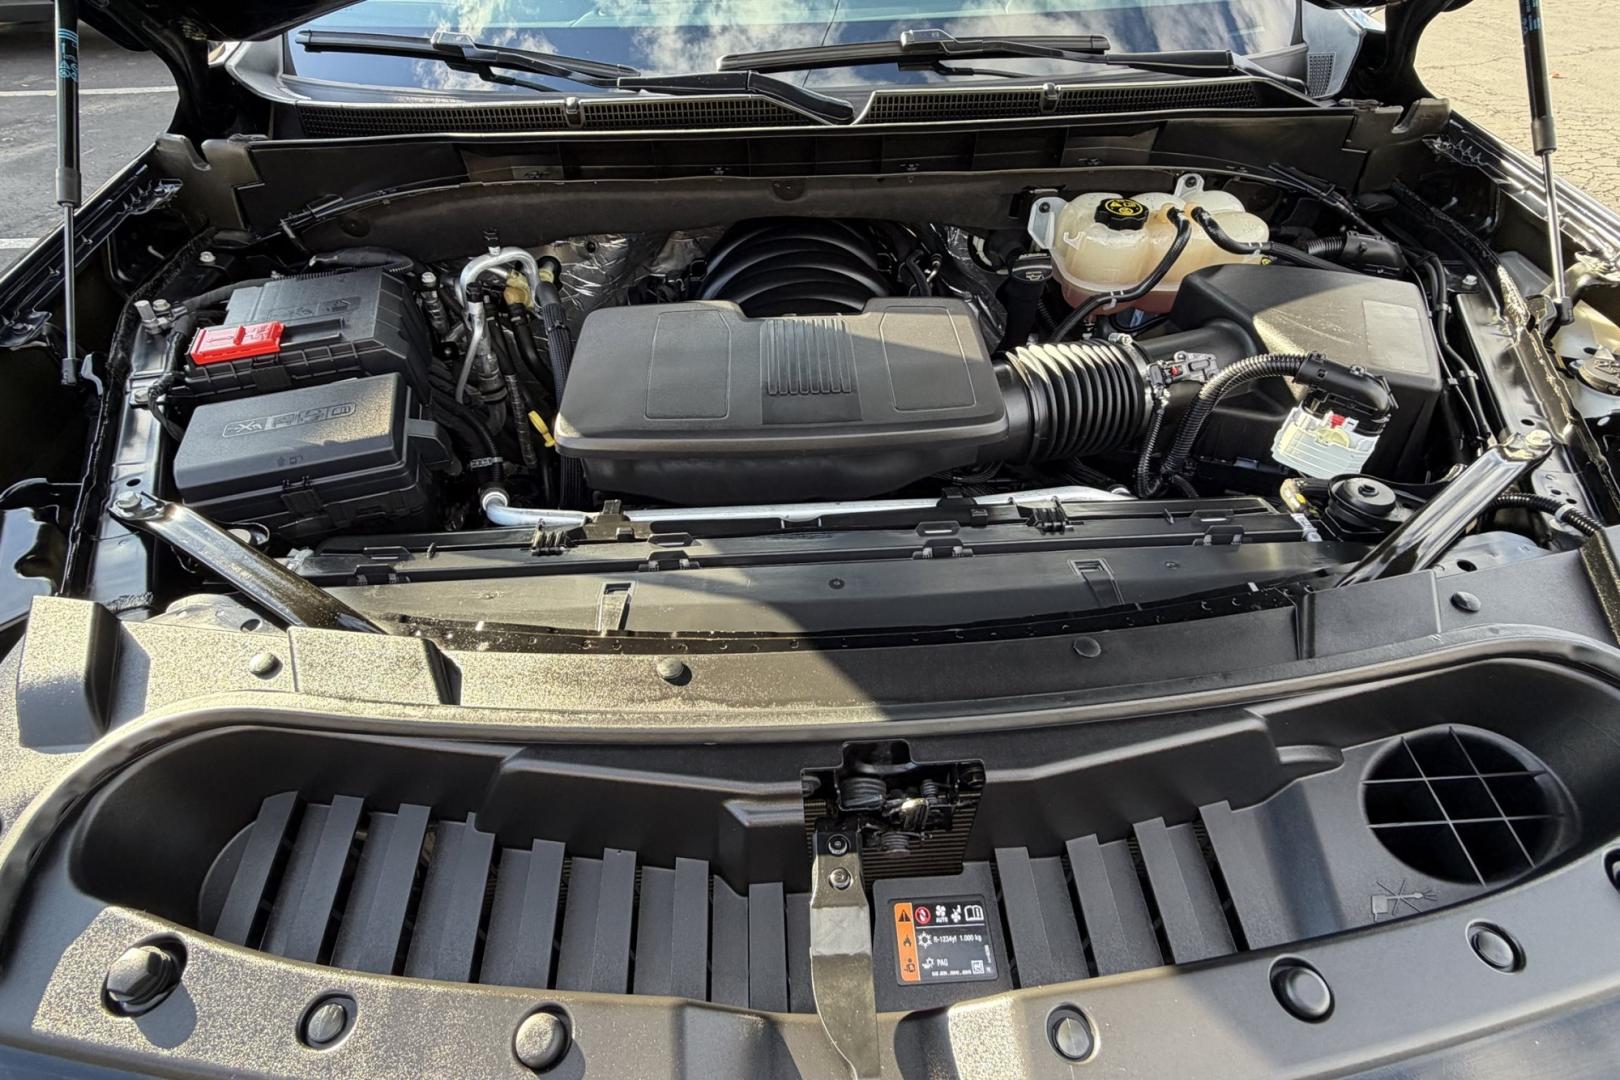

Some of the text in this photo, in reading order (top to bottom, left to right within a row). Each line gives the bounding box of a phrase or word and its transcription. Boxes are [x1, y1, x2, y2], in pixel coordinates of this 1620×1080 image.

[960, 934, 974, 942] 1.000
[975, 934, 982, 942] kg
[936, 958, 948, 966] PAG
